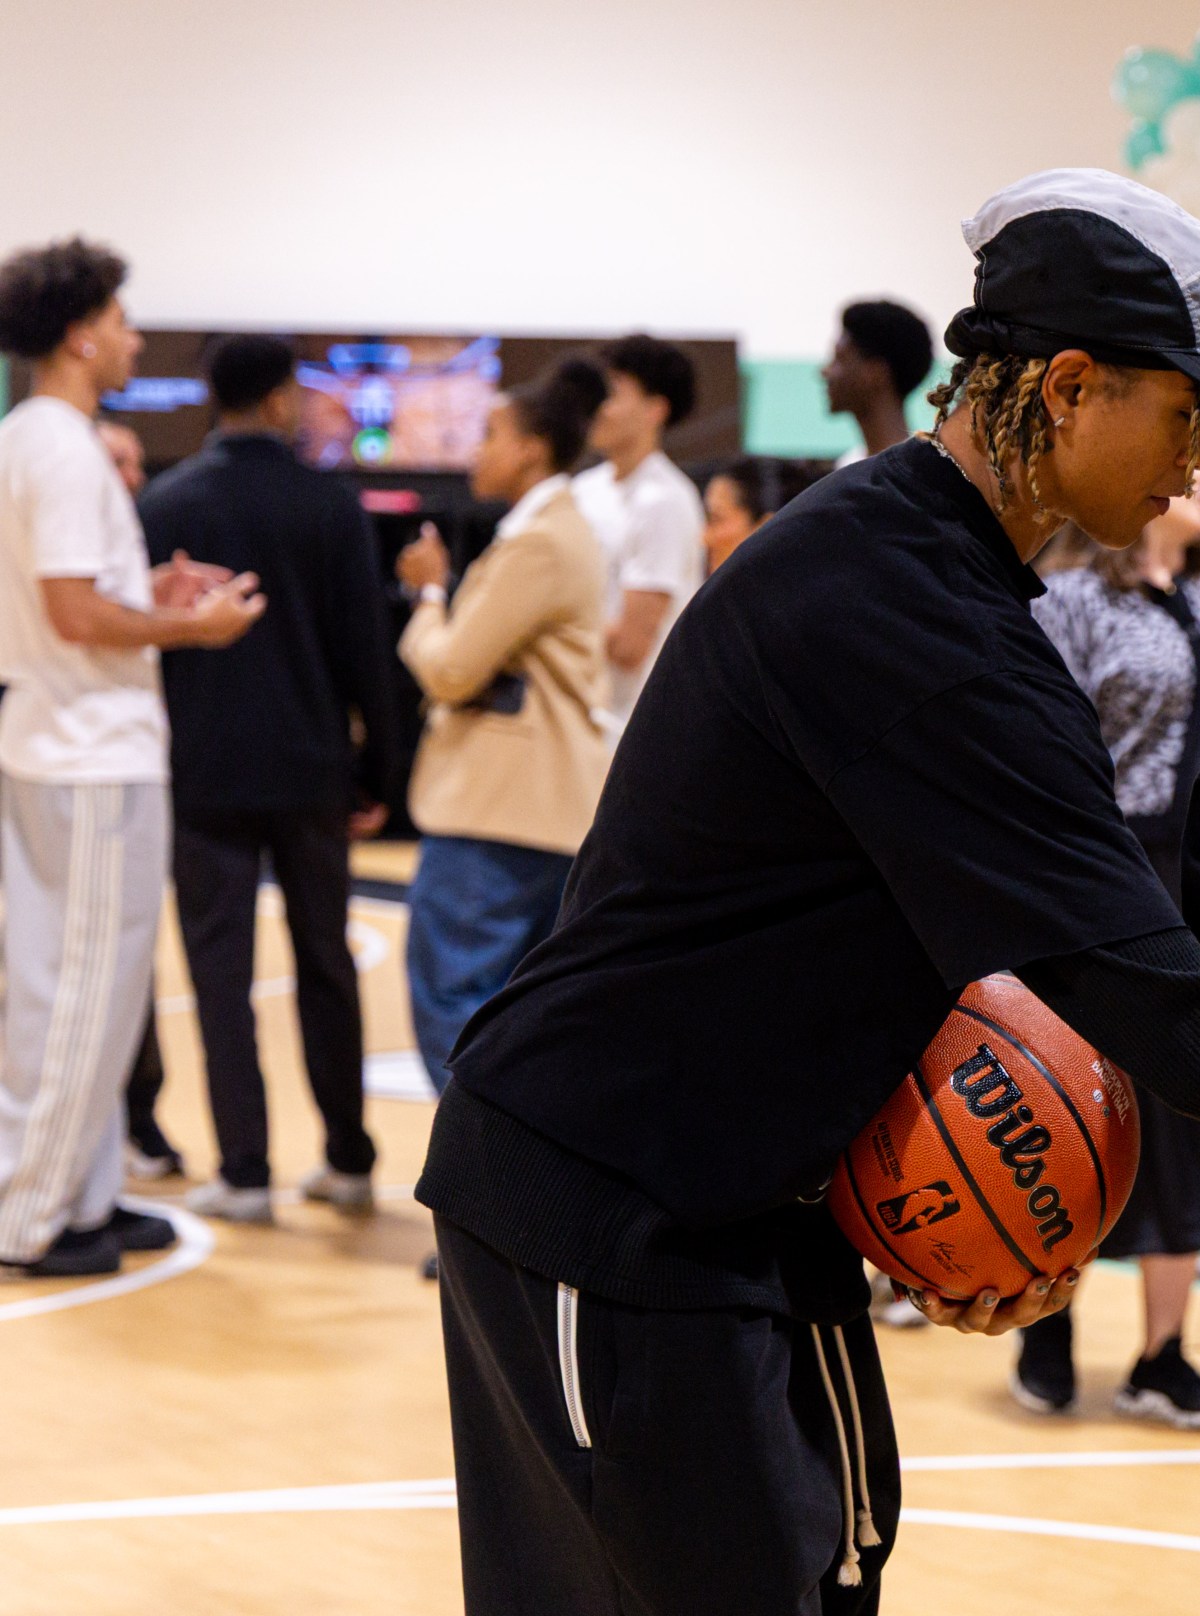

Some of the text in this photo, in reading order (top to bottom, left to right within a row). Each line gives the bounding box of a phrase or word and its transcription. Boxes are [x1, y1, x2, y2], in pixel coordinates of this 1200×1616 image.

[1091, 1060, 1127, 1126] BASKETBALL
[1102, 1057, 1131, 1110] BROOKLYN
[951, 1043, 1075, 1252] Wilson
[879, 1205, 898, 1227] NBA
